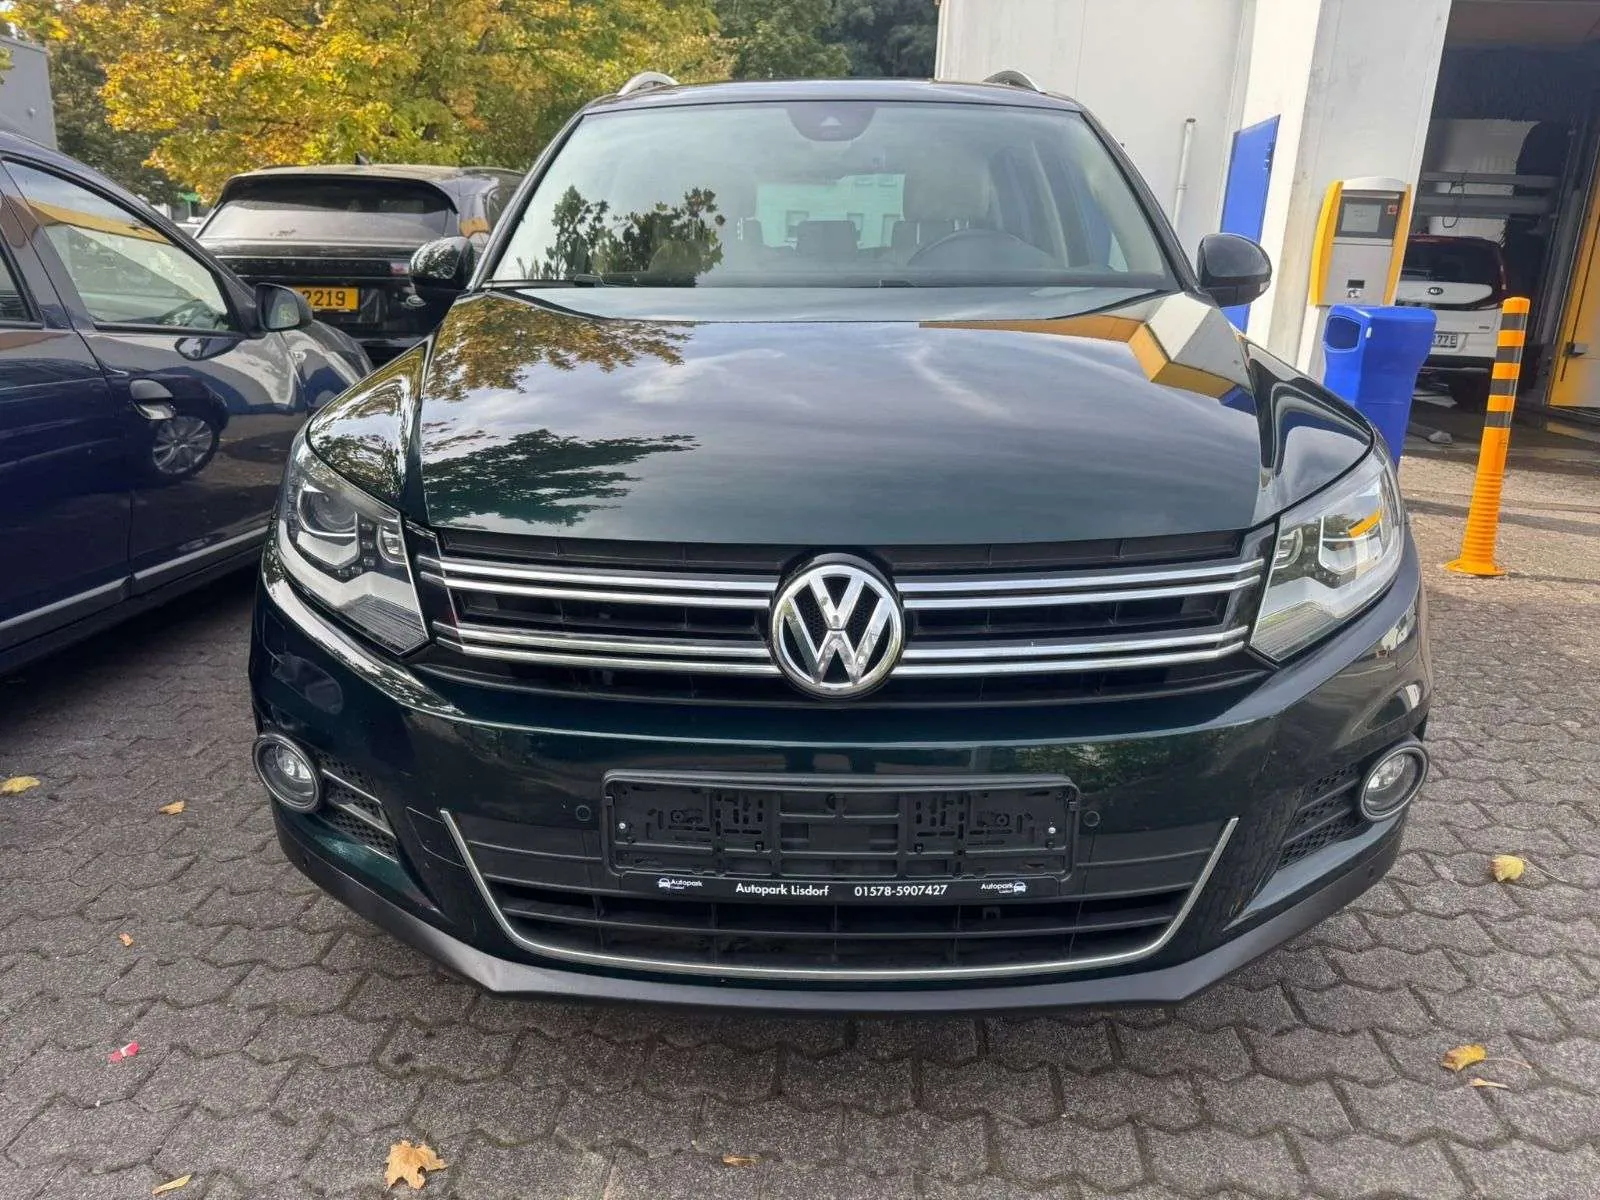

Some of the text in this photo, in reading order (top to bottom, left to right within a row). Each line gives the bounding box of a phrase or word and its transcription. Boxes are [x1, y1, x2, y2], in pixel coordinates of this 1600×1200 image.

[670, 879, 703, 888] Autopark
[981, 882, 1014, 890] Autopark
[735, 883, 948, 896] Autopark Lisdorf 01578-5907427
